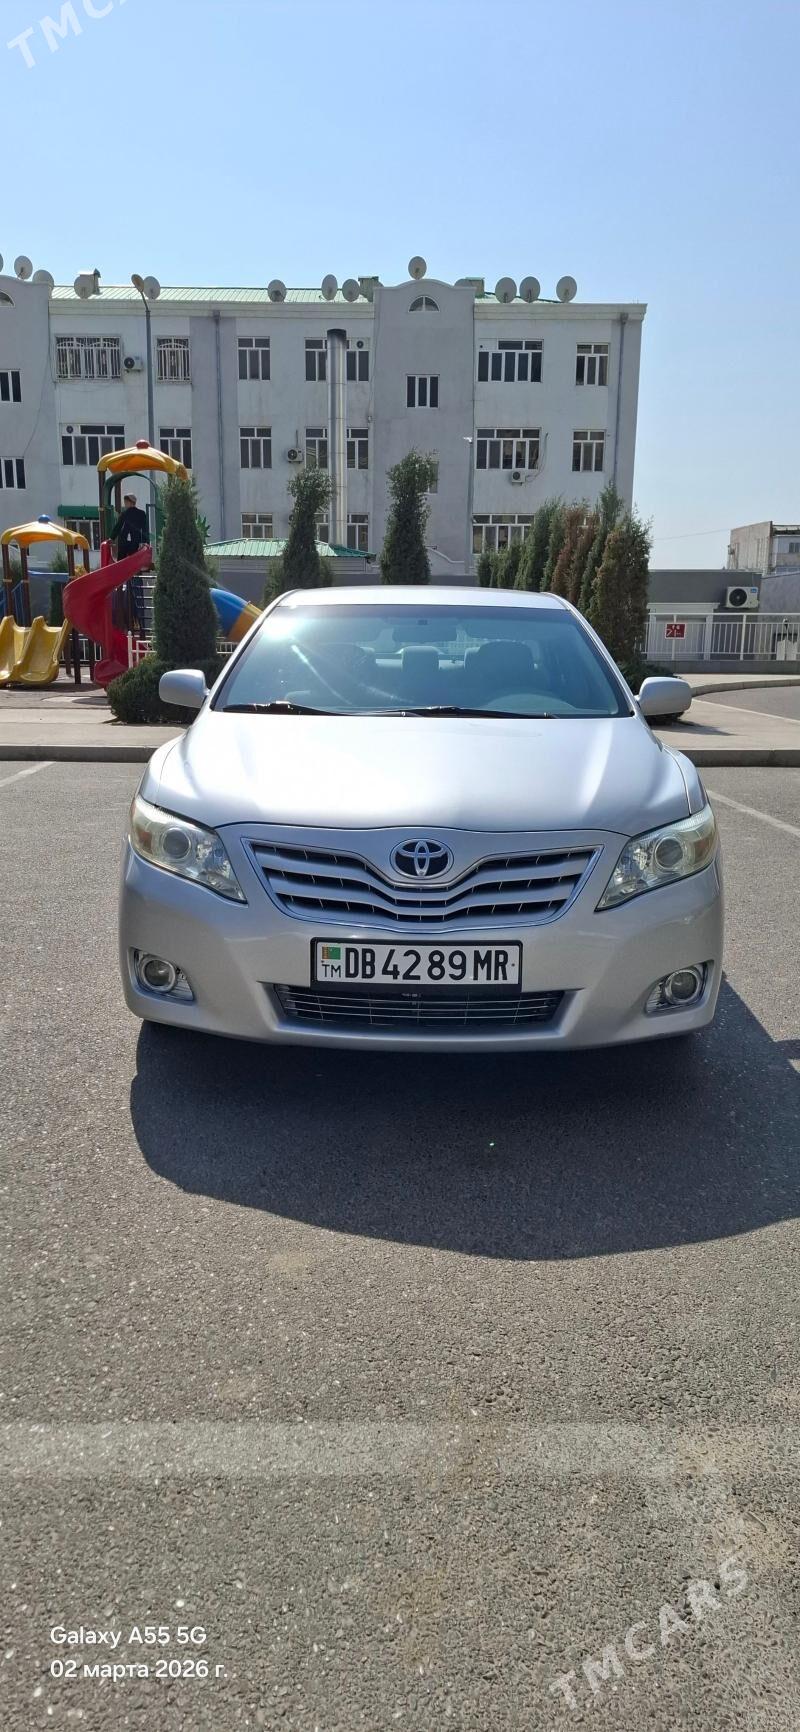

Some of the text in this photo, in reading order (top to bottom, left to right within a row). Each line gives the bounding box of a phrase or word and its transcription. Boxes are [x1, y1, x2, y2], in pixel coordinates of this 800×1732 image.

[321, 963, 342, 978] TM
[345, 947, 509, 981] DB 4289 MR
